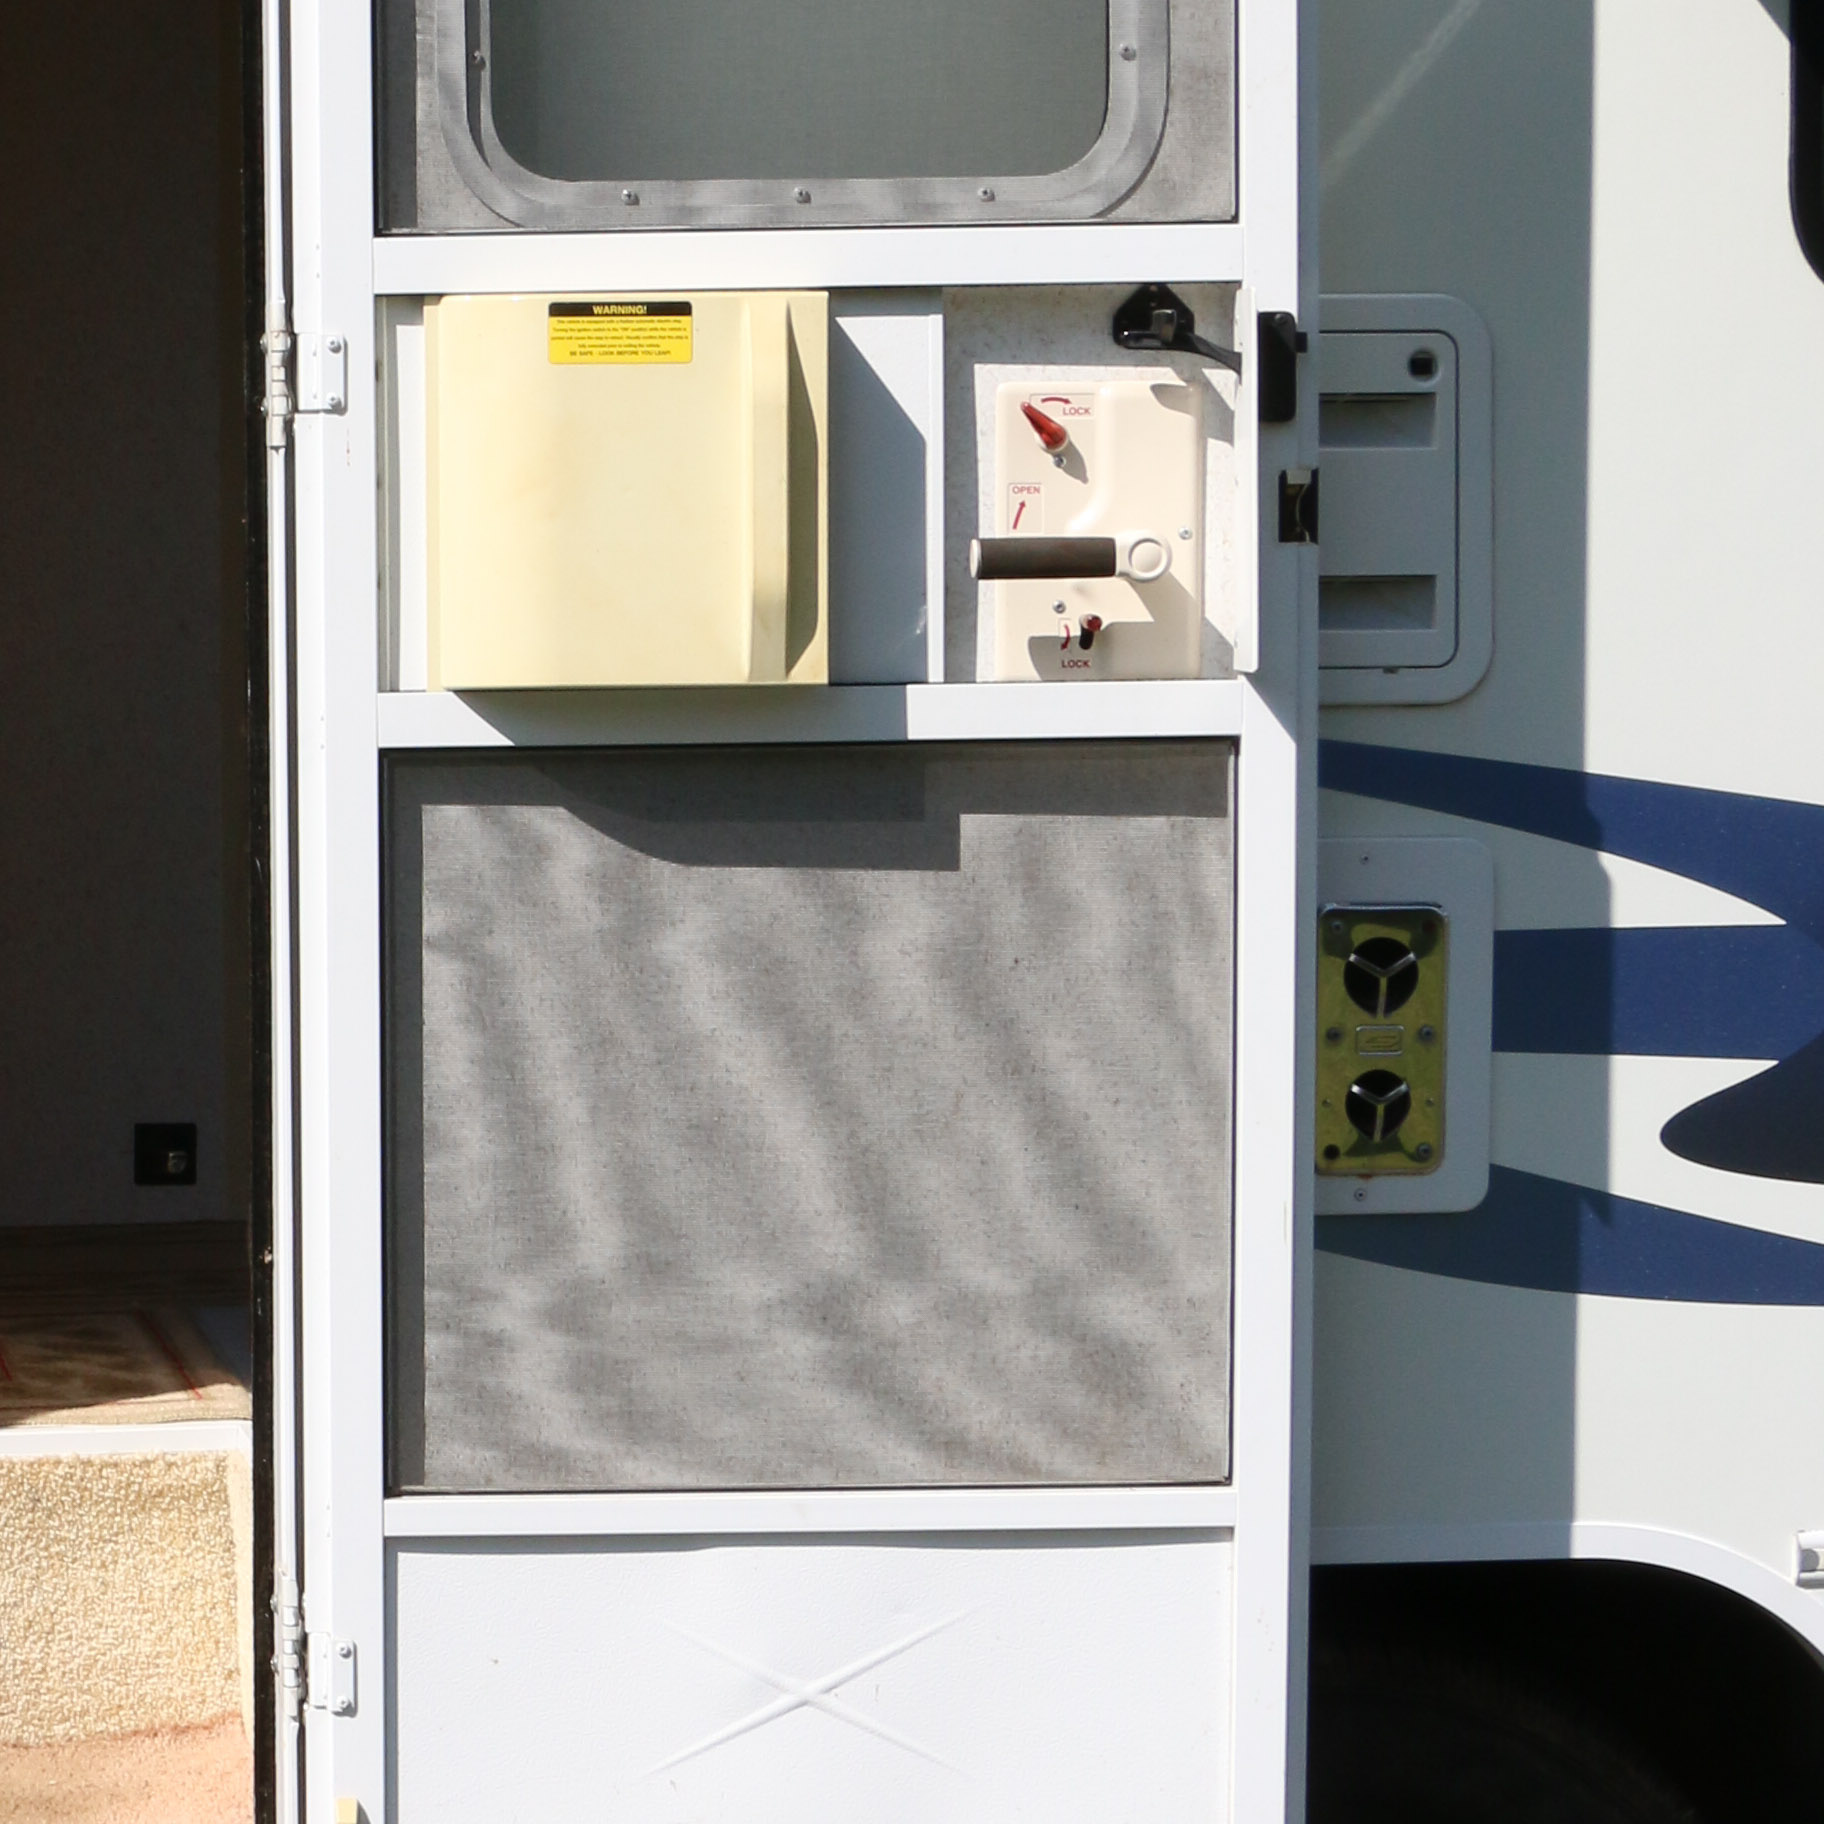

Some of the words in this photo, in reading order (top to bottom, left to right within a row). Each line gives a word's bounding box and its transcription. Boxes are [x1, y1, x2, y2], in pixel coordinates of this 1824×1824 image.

[592, 304, 648, 315] WARNING!
[1062, 406, 1091, 416] LOCK
[1012, 485, 1041, 495] OPEN
[1061, 659, 1091, 668] LOCK
